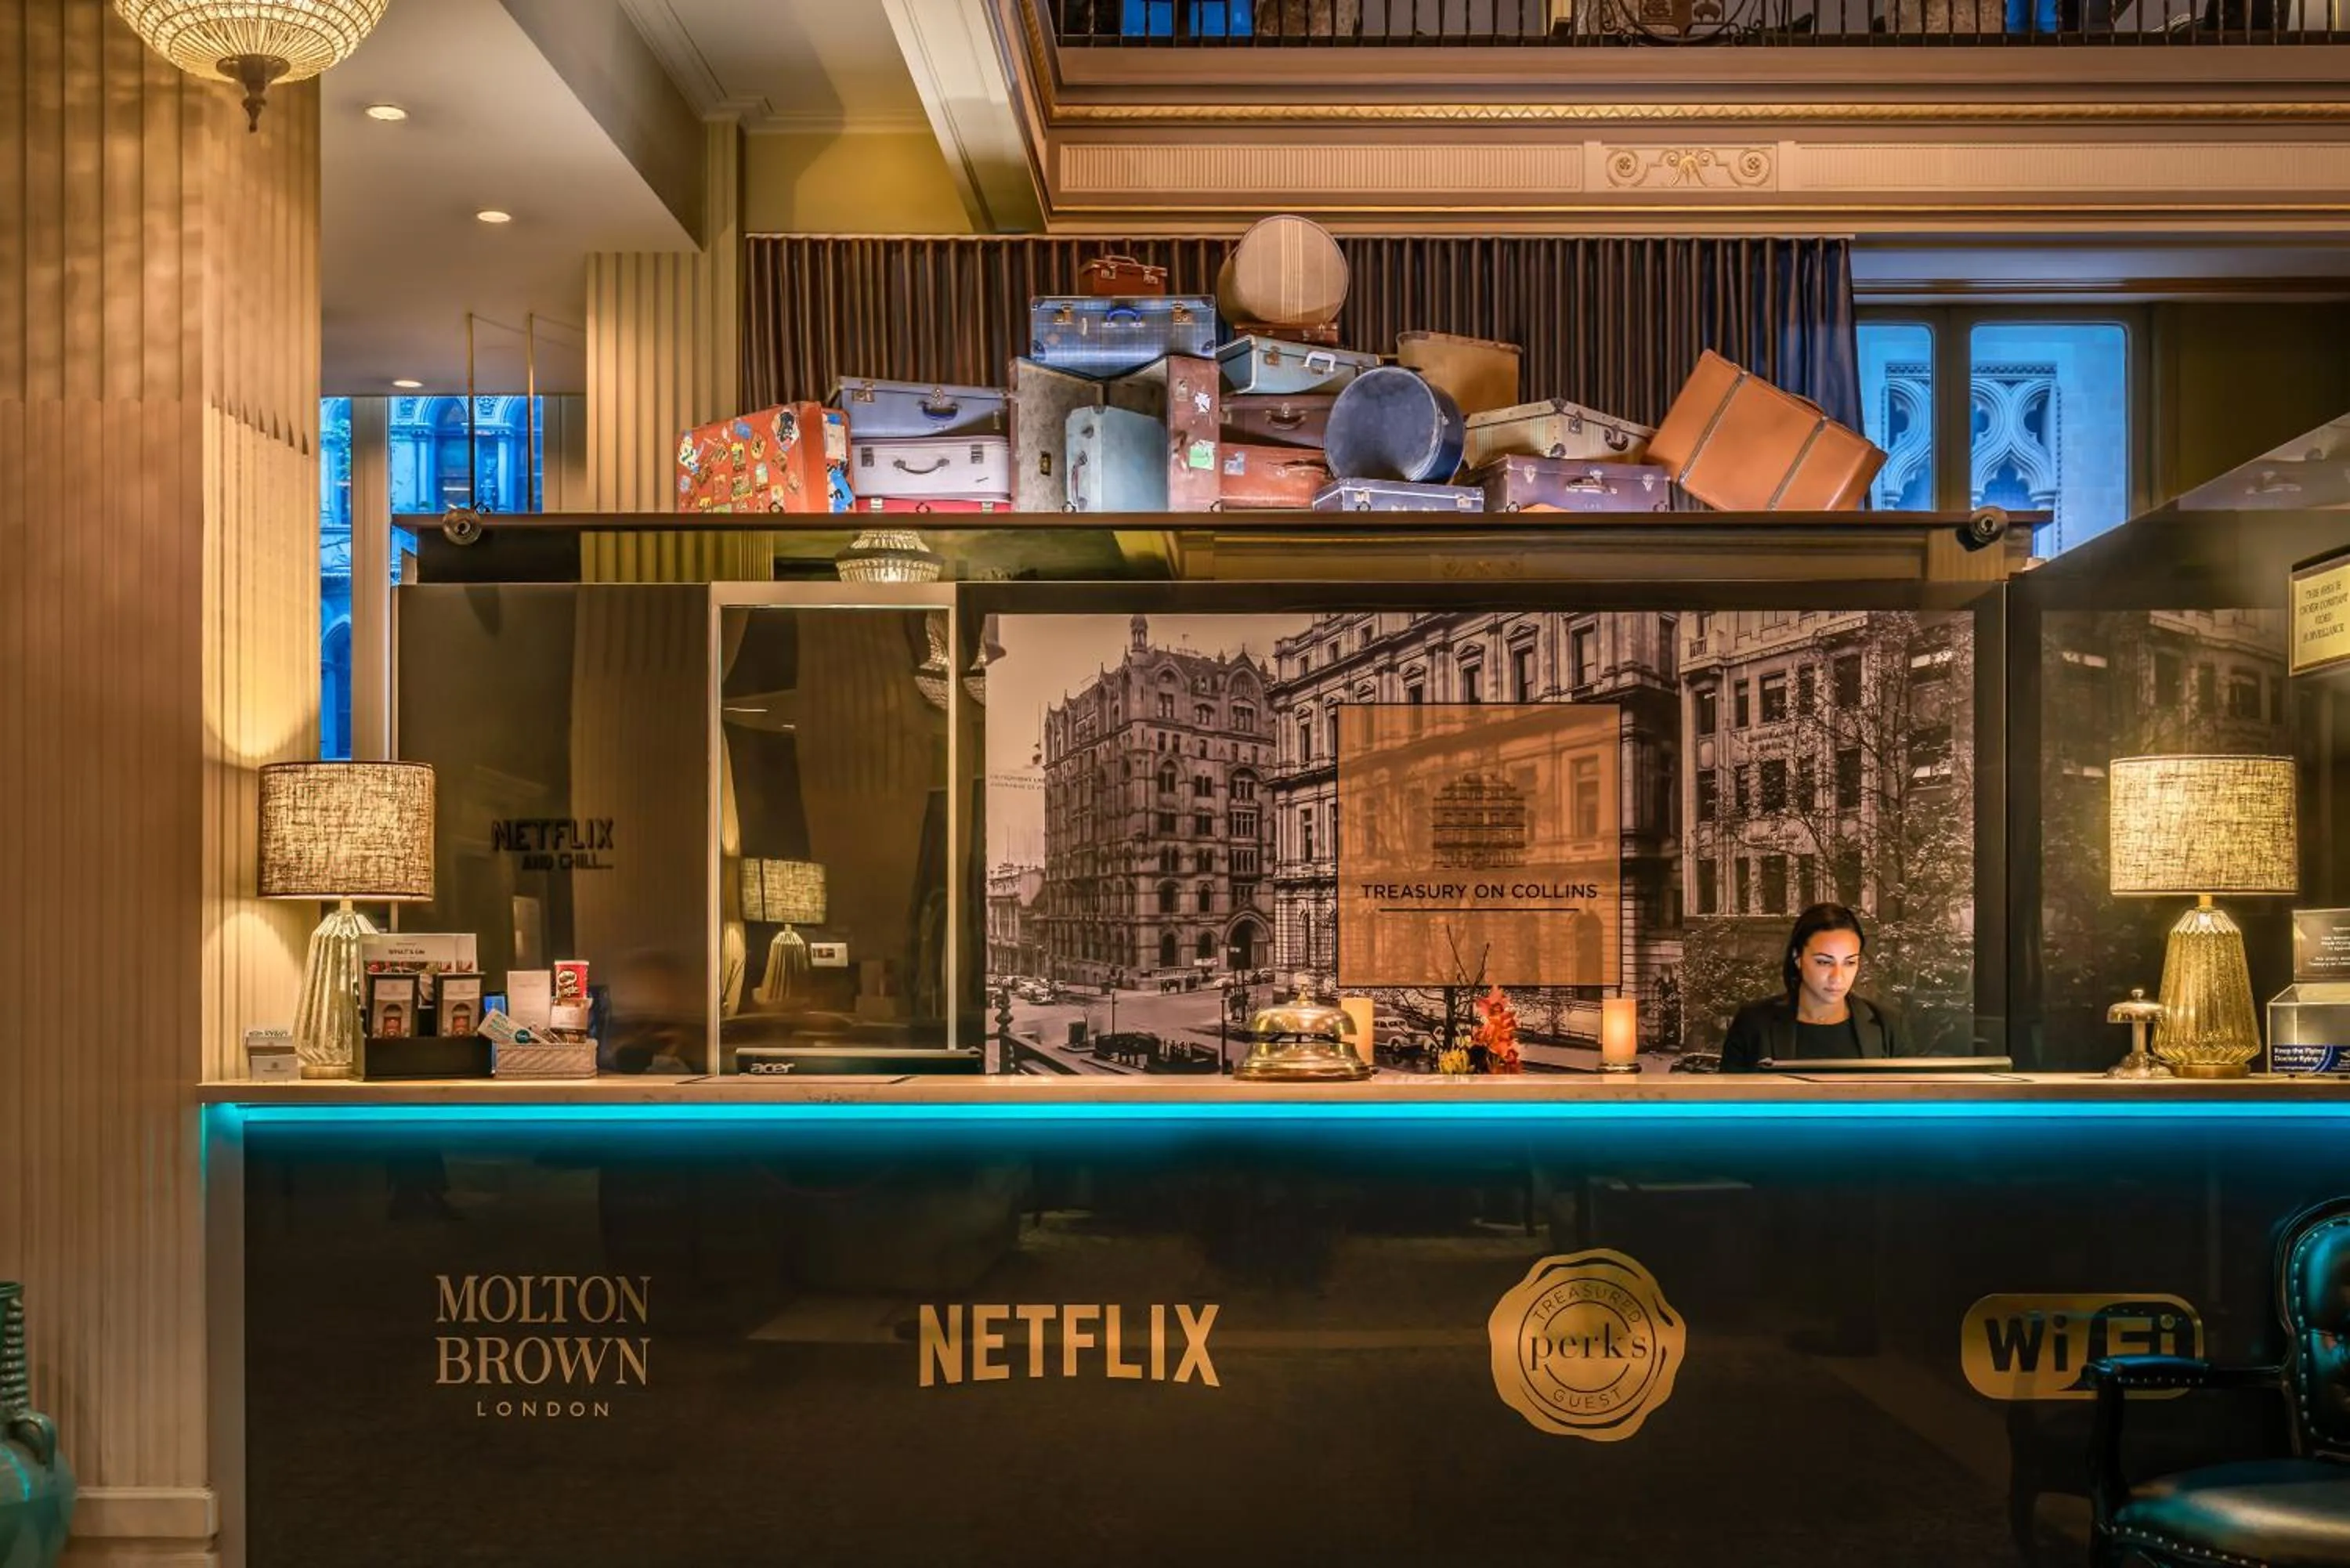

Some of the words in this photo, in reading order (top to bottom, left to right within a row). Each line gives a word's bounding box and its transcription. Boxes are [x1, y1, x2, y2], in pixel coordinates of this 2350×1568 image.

[491, 818, 614, 851] NETFLIX
[1361, 883, 1467, 899] TREASURY
[1474, 884, 1504, 899] ON
[1511, 883, 1598, 899] COLLINS
[750, 1063, 795, 1074] acer
[436, 1274, 652, 1324] MOLTON
[1533, 1284, 1642, 1324] TREASURED
[435, 1336, 652, 1386] BROWN
[919, 1303, 1220, 1388] NETFLIX
[1529, 1321, 1648, 1371] perks
[477, 1400, 609, 1417] LONDON
[1553, 1387, 1624, 1409] GUEST
